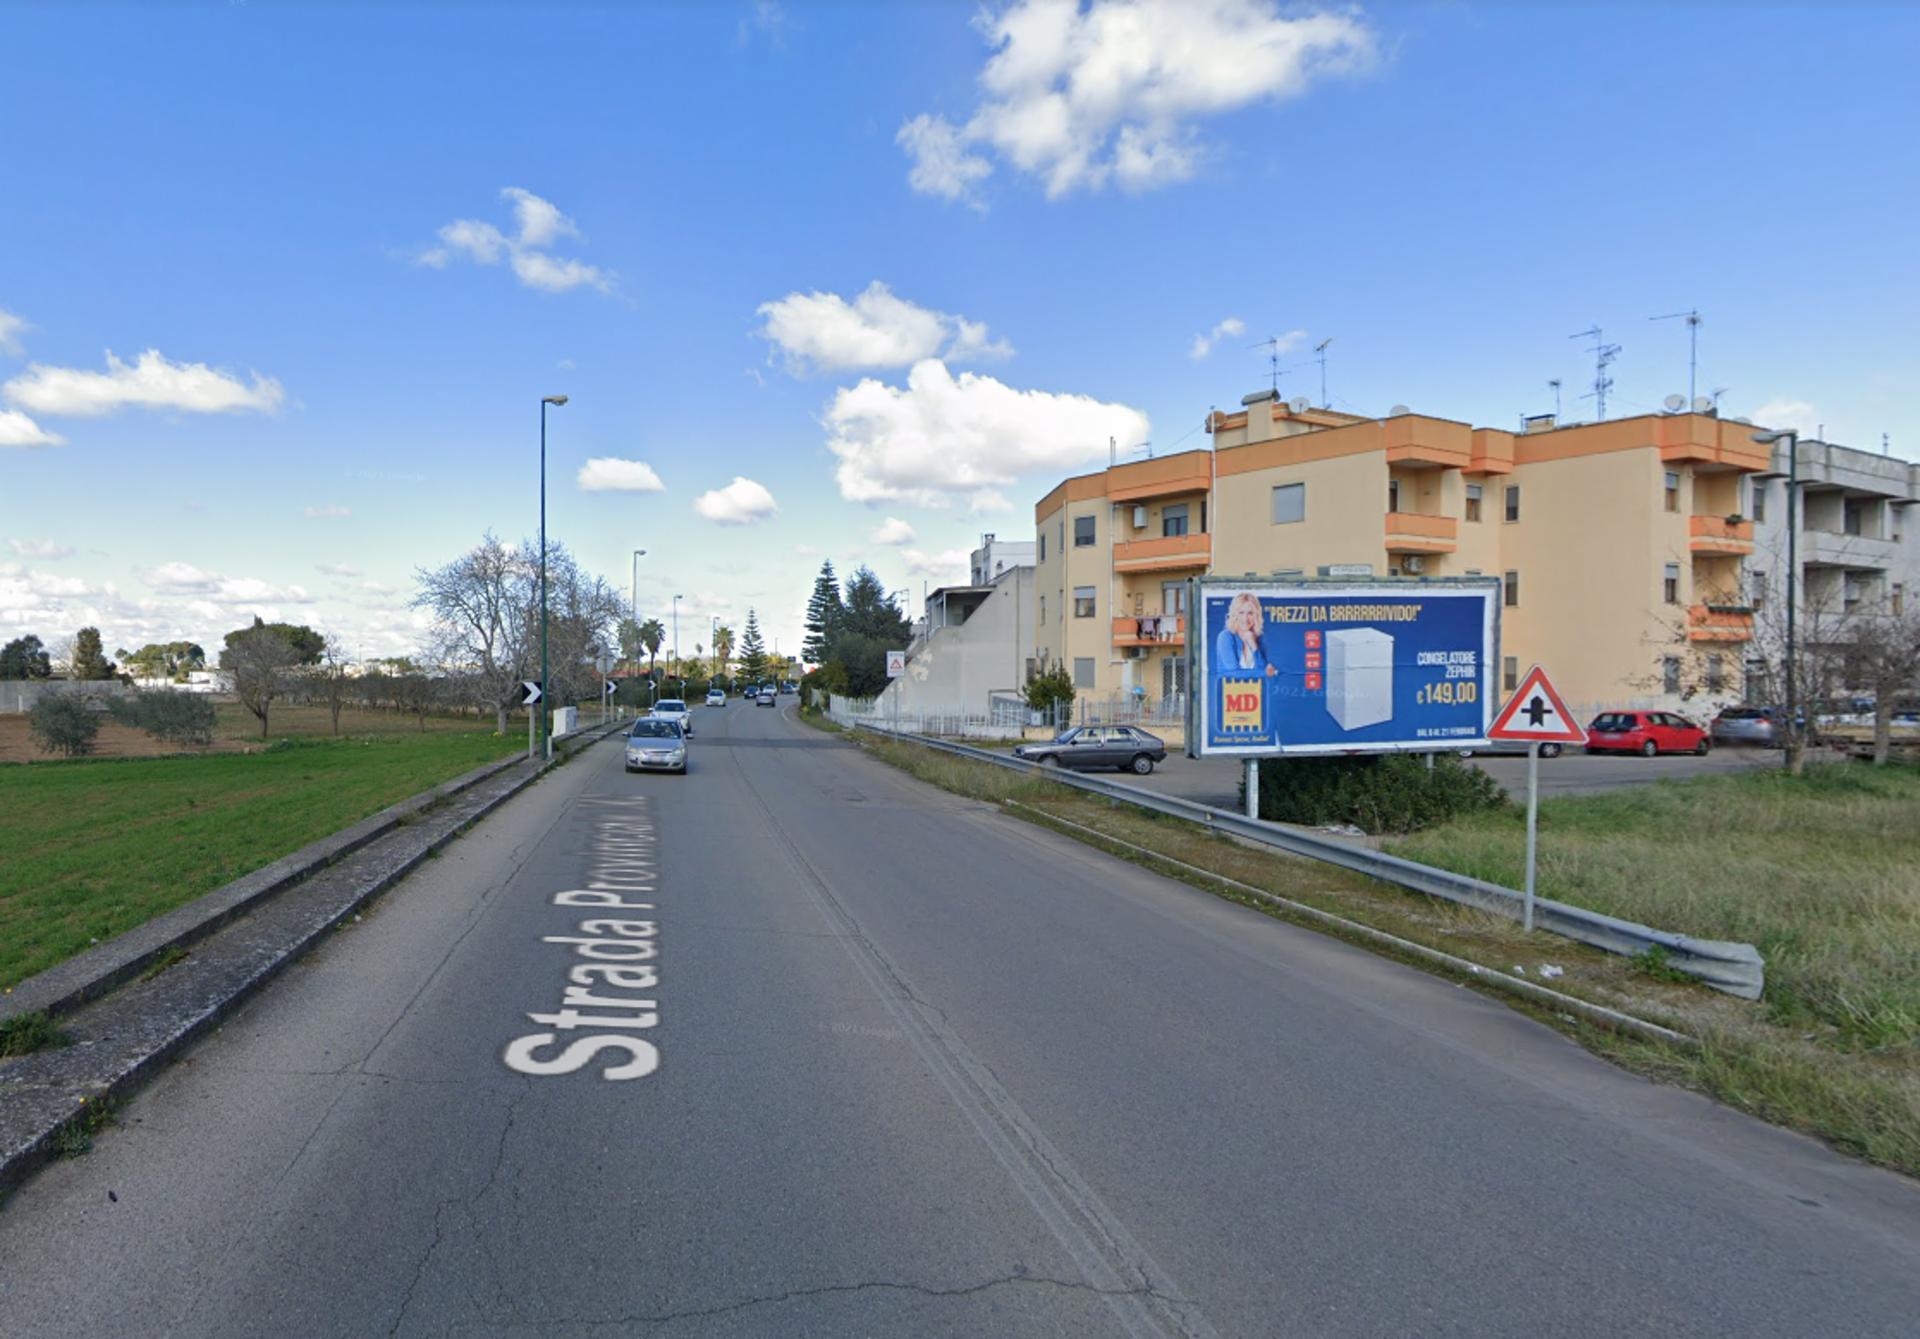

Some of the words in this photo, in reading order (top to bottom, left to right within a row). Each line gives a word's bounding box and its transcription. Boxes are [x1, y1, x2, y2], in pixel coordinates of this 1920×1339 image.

[1264, 605, 1309, 622] "PREZZI
[1312, 604, 1327, 622] DA
[1417, 651, 1476, 666] CONGELATORE
[1226, 694, 1258, 712] MD
